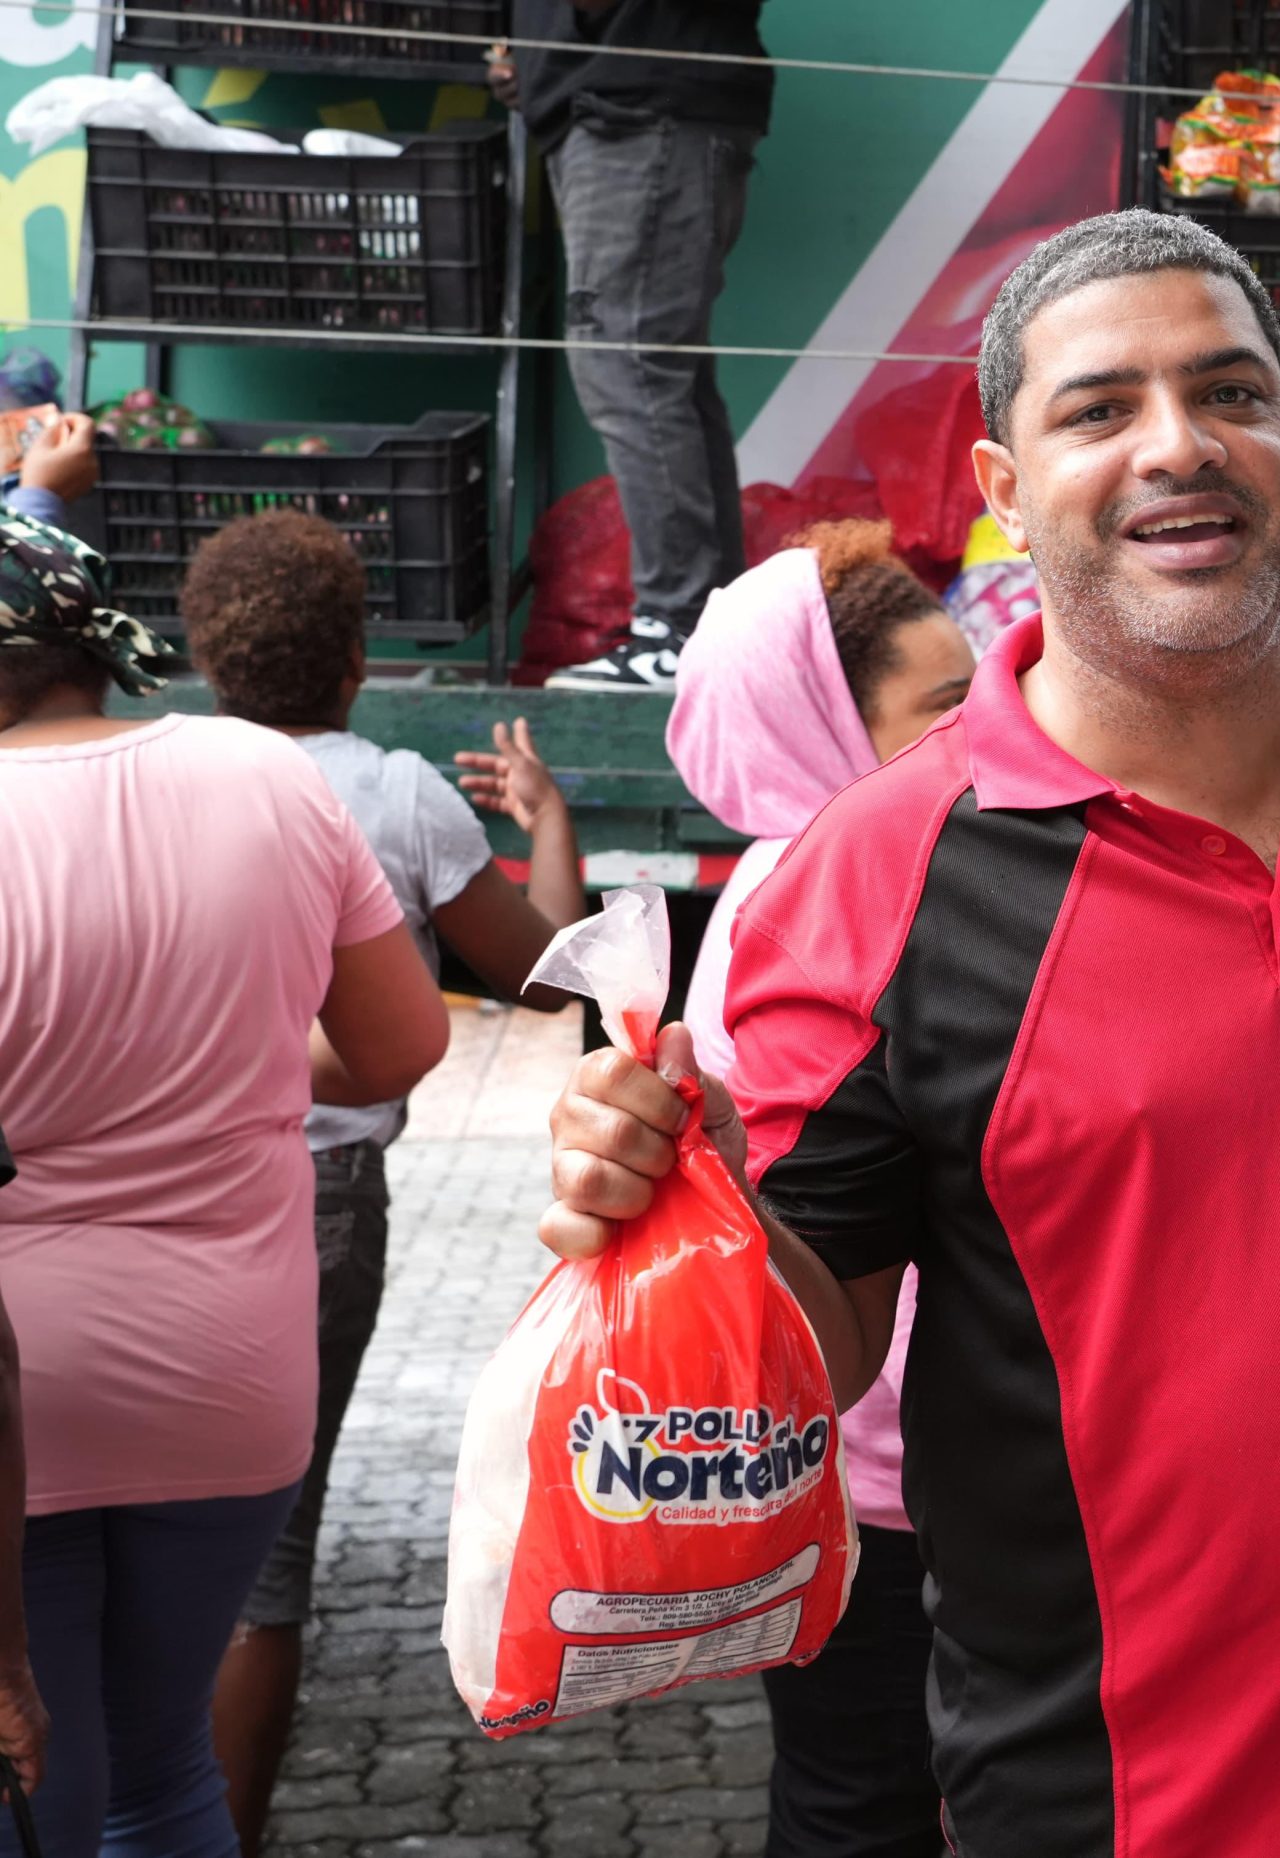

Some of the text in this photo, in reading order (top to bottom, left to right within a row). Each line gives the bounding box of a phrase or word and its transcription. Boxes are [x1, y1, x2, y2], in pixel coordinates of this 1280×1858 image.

[596, 1419, 829, 1501] Norteño
[662, 1506, 715, 1520] Calidad
[720, 1508, 729, 1521] y
[799, 1468, 822, 1491] norte
[597, 1595, 689, 1606] AGROPECUARIA
[693, 1590, 731, 1603] JOCHY
[733, 1570, 779, 1595] POLANCO
[609, 1606, 647, 1615] Carretera
[578, 1648, 609, 1657] Datos
